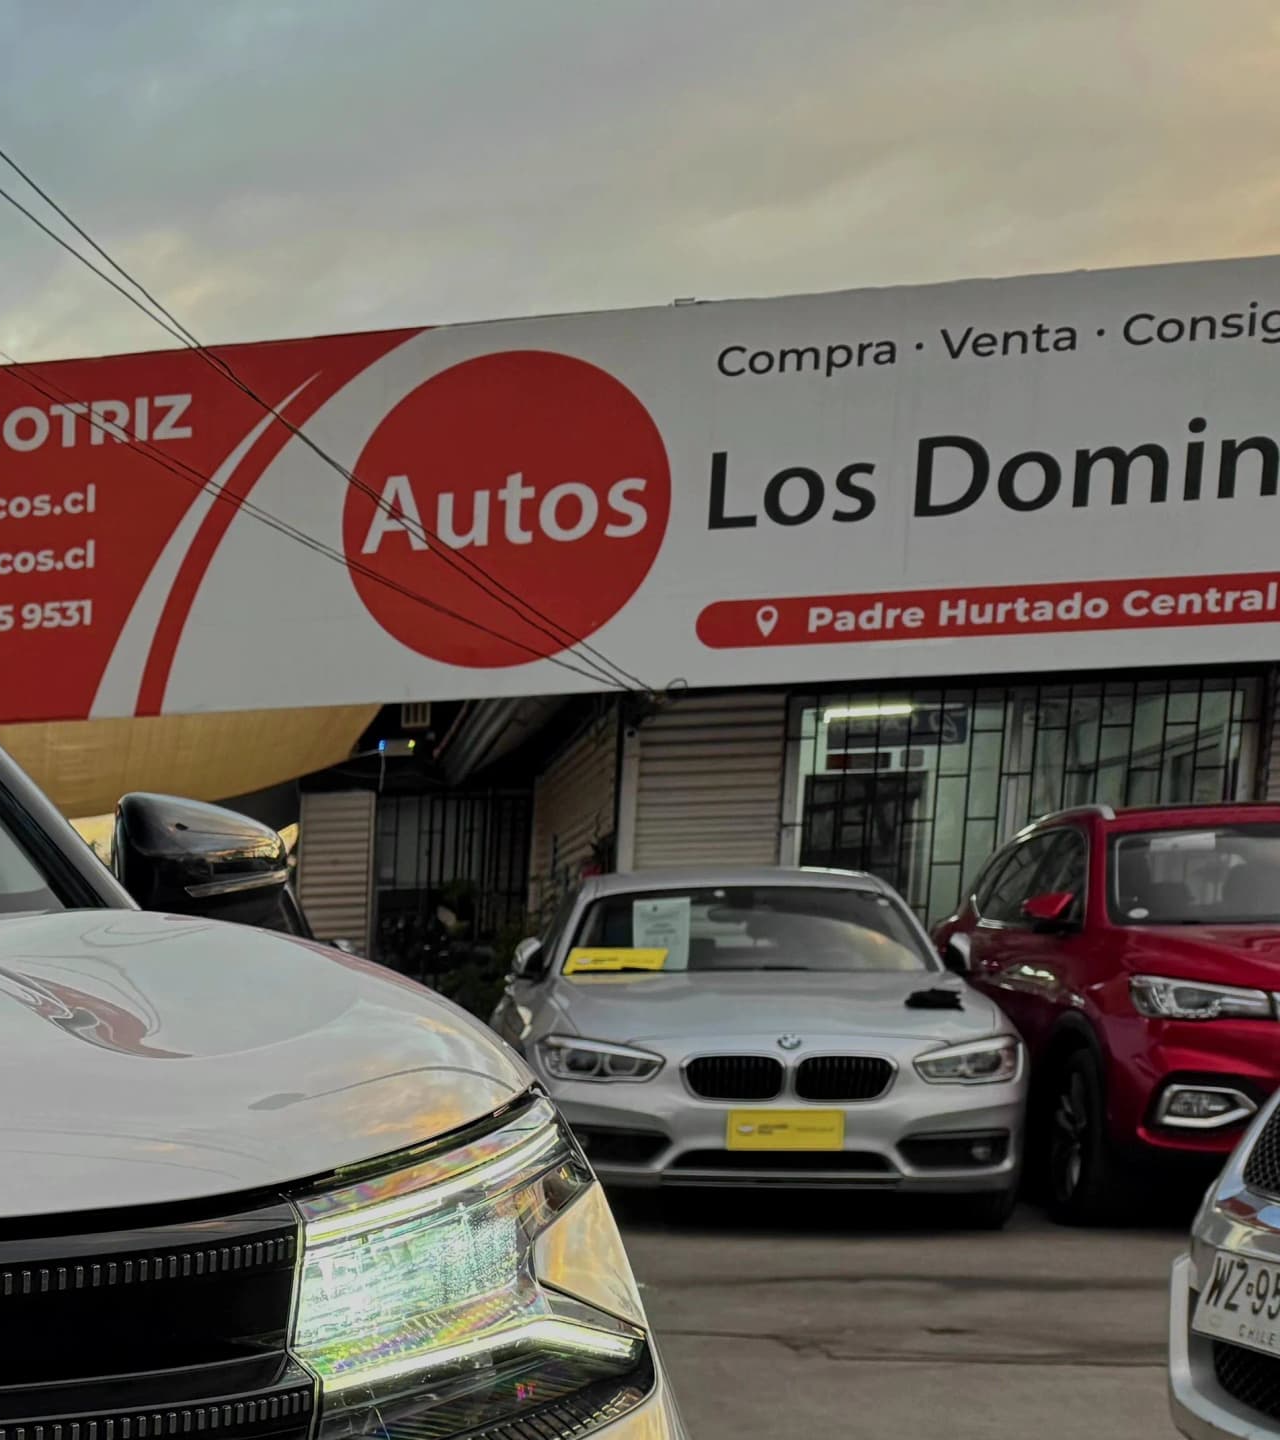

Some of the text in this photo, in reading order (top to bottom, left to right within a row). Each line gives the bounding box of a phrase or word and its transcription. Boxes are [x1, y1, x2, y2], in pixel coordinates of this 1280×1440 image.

[717, 340, 897, 377] Compra
[940, 323, 1078, 360] Venta
[708, 417, 1280, 530] Los Domin
[361, 472, 648, 554] Autos
[21, 599, 93, 629] 9531
[807, 582, 1278, 633] Padre Hurtado Central
